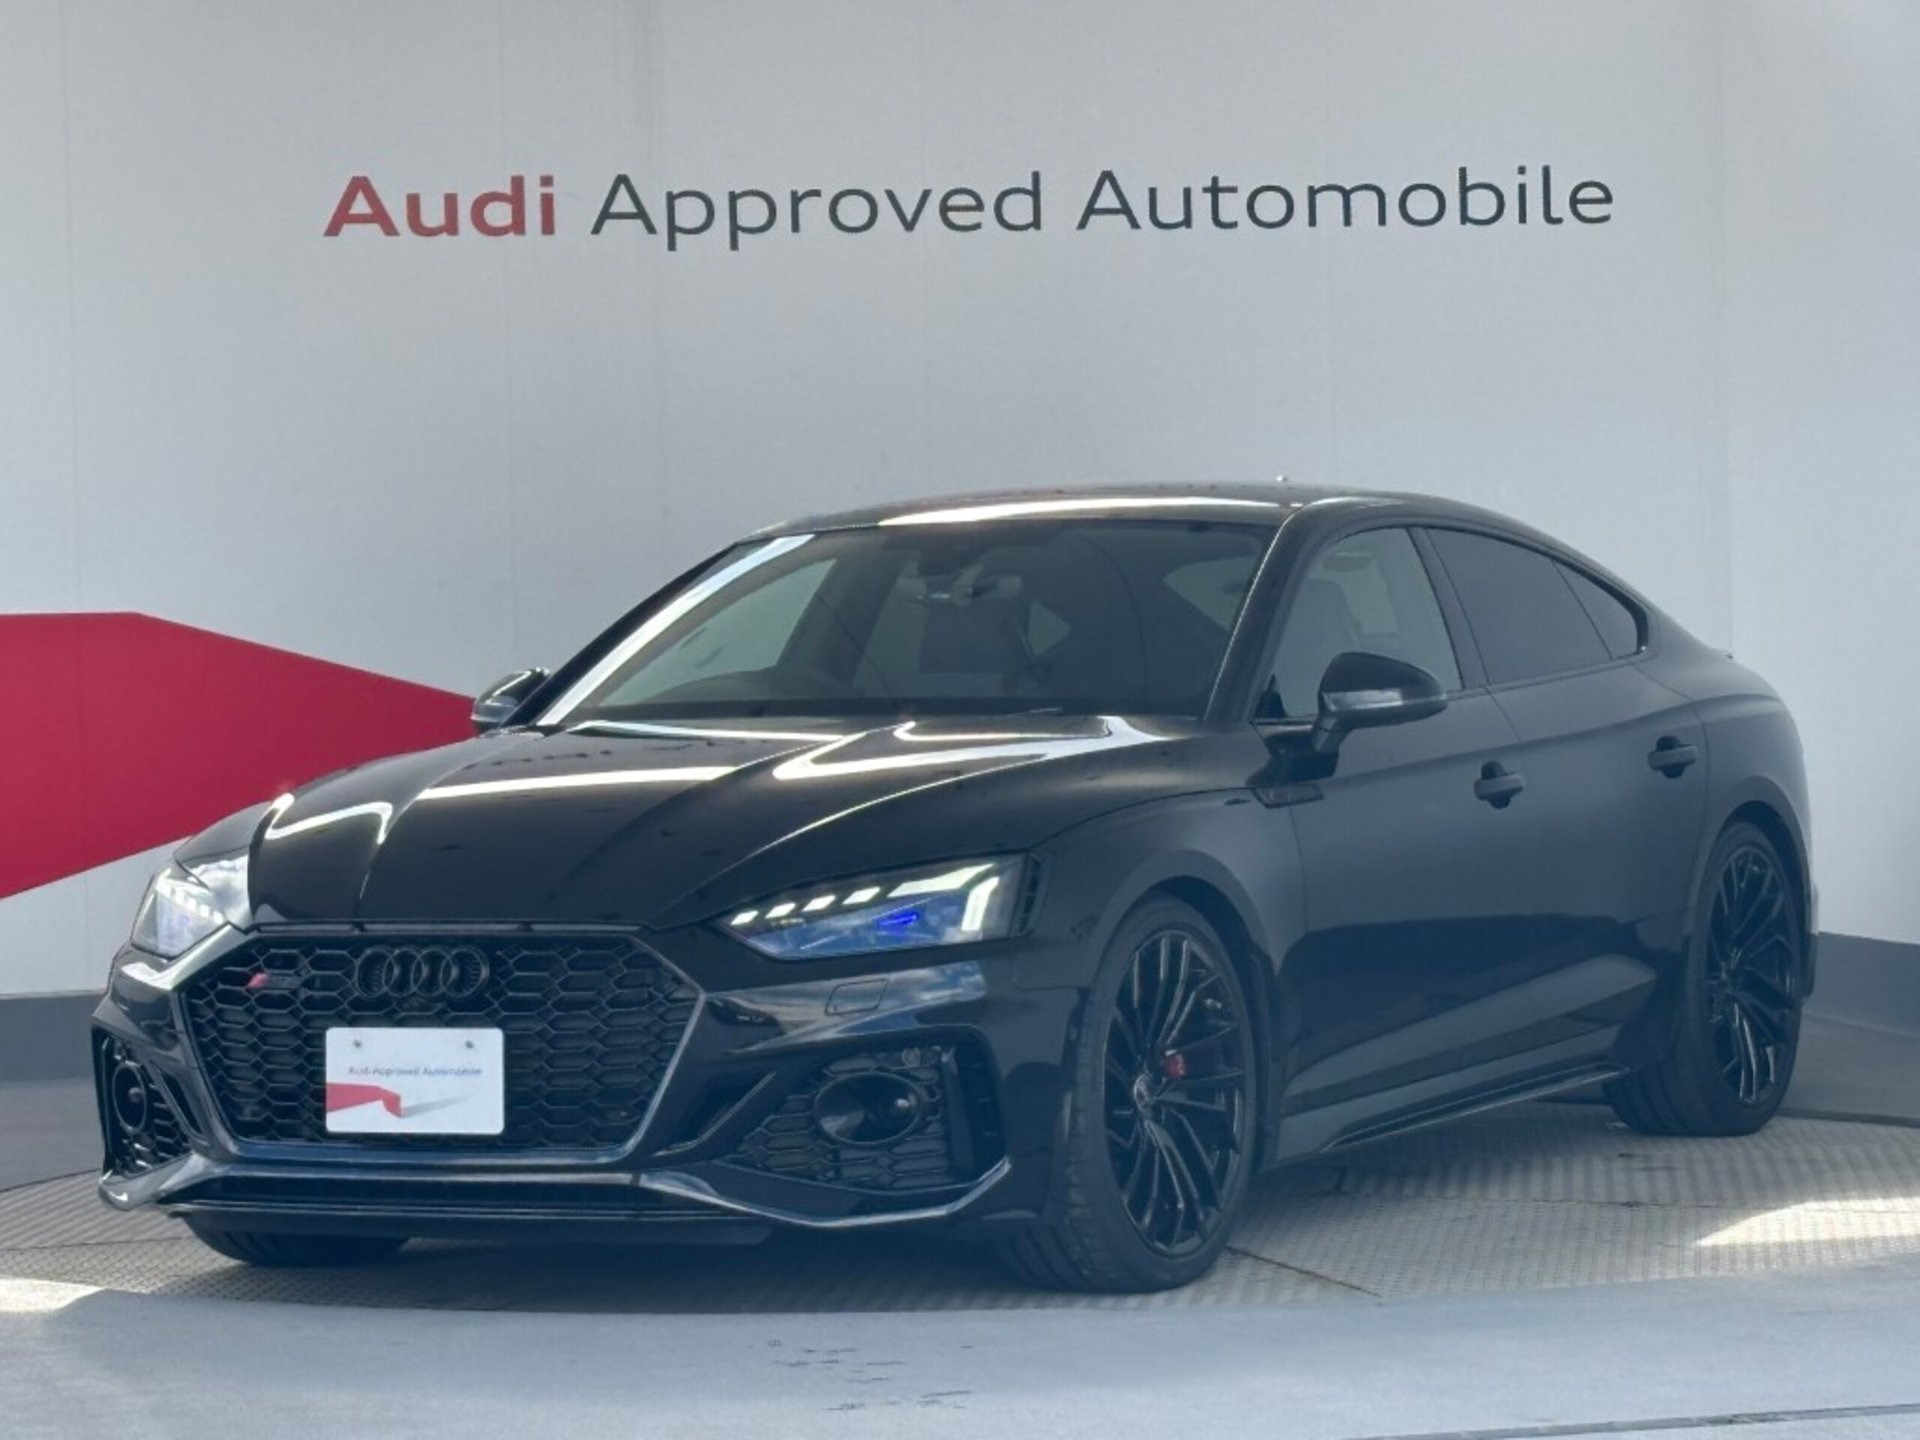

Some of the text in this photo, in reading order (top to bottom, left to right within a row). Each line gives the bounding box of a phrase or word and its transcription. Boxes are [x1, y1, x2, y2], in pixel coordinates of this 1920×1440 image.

[323, 164, 1613, 251] Audi Approved Automobile
